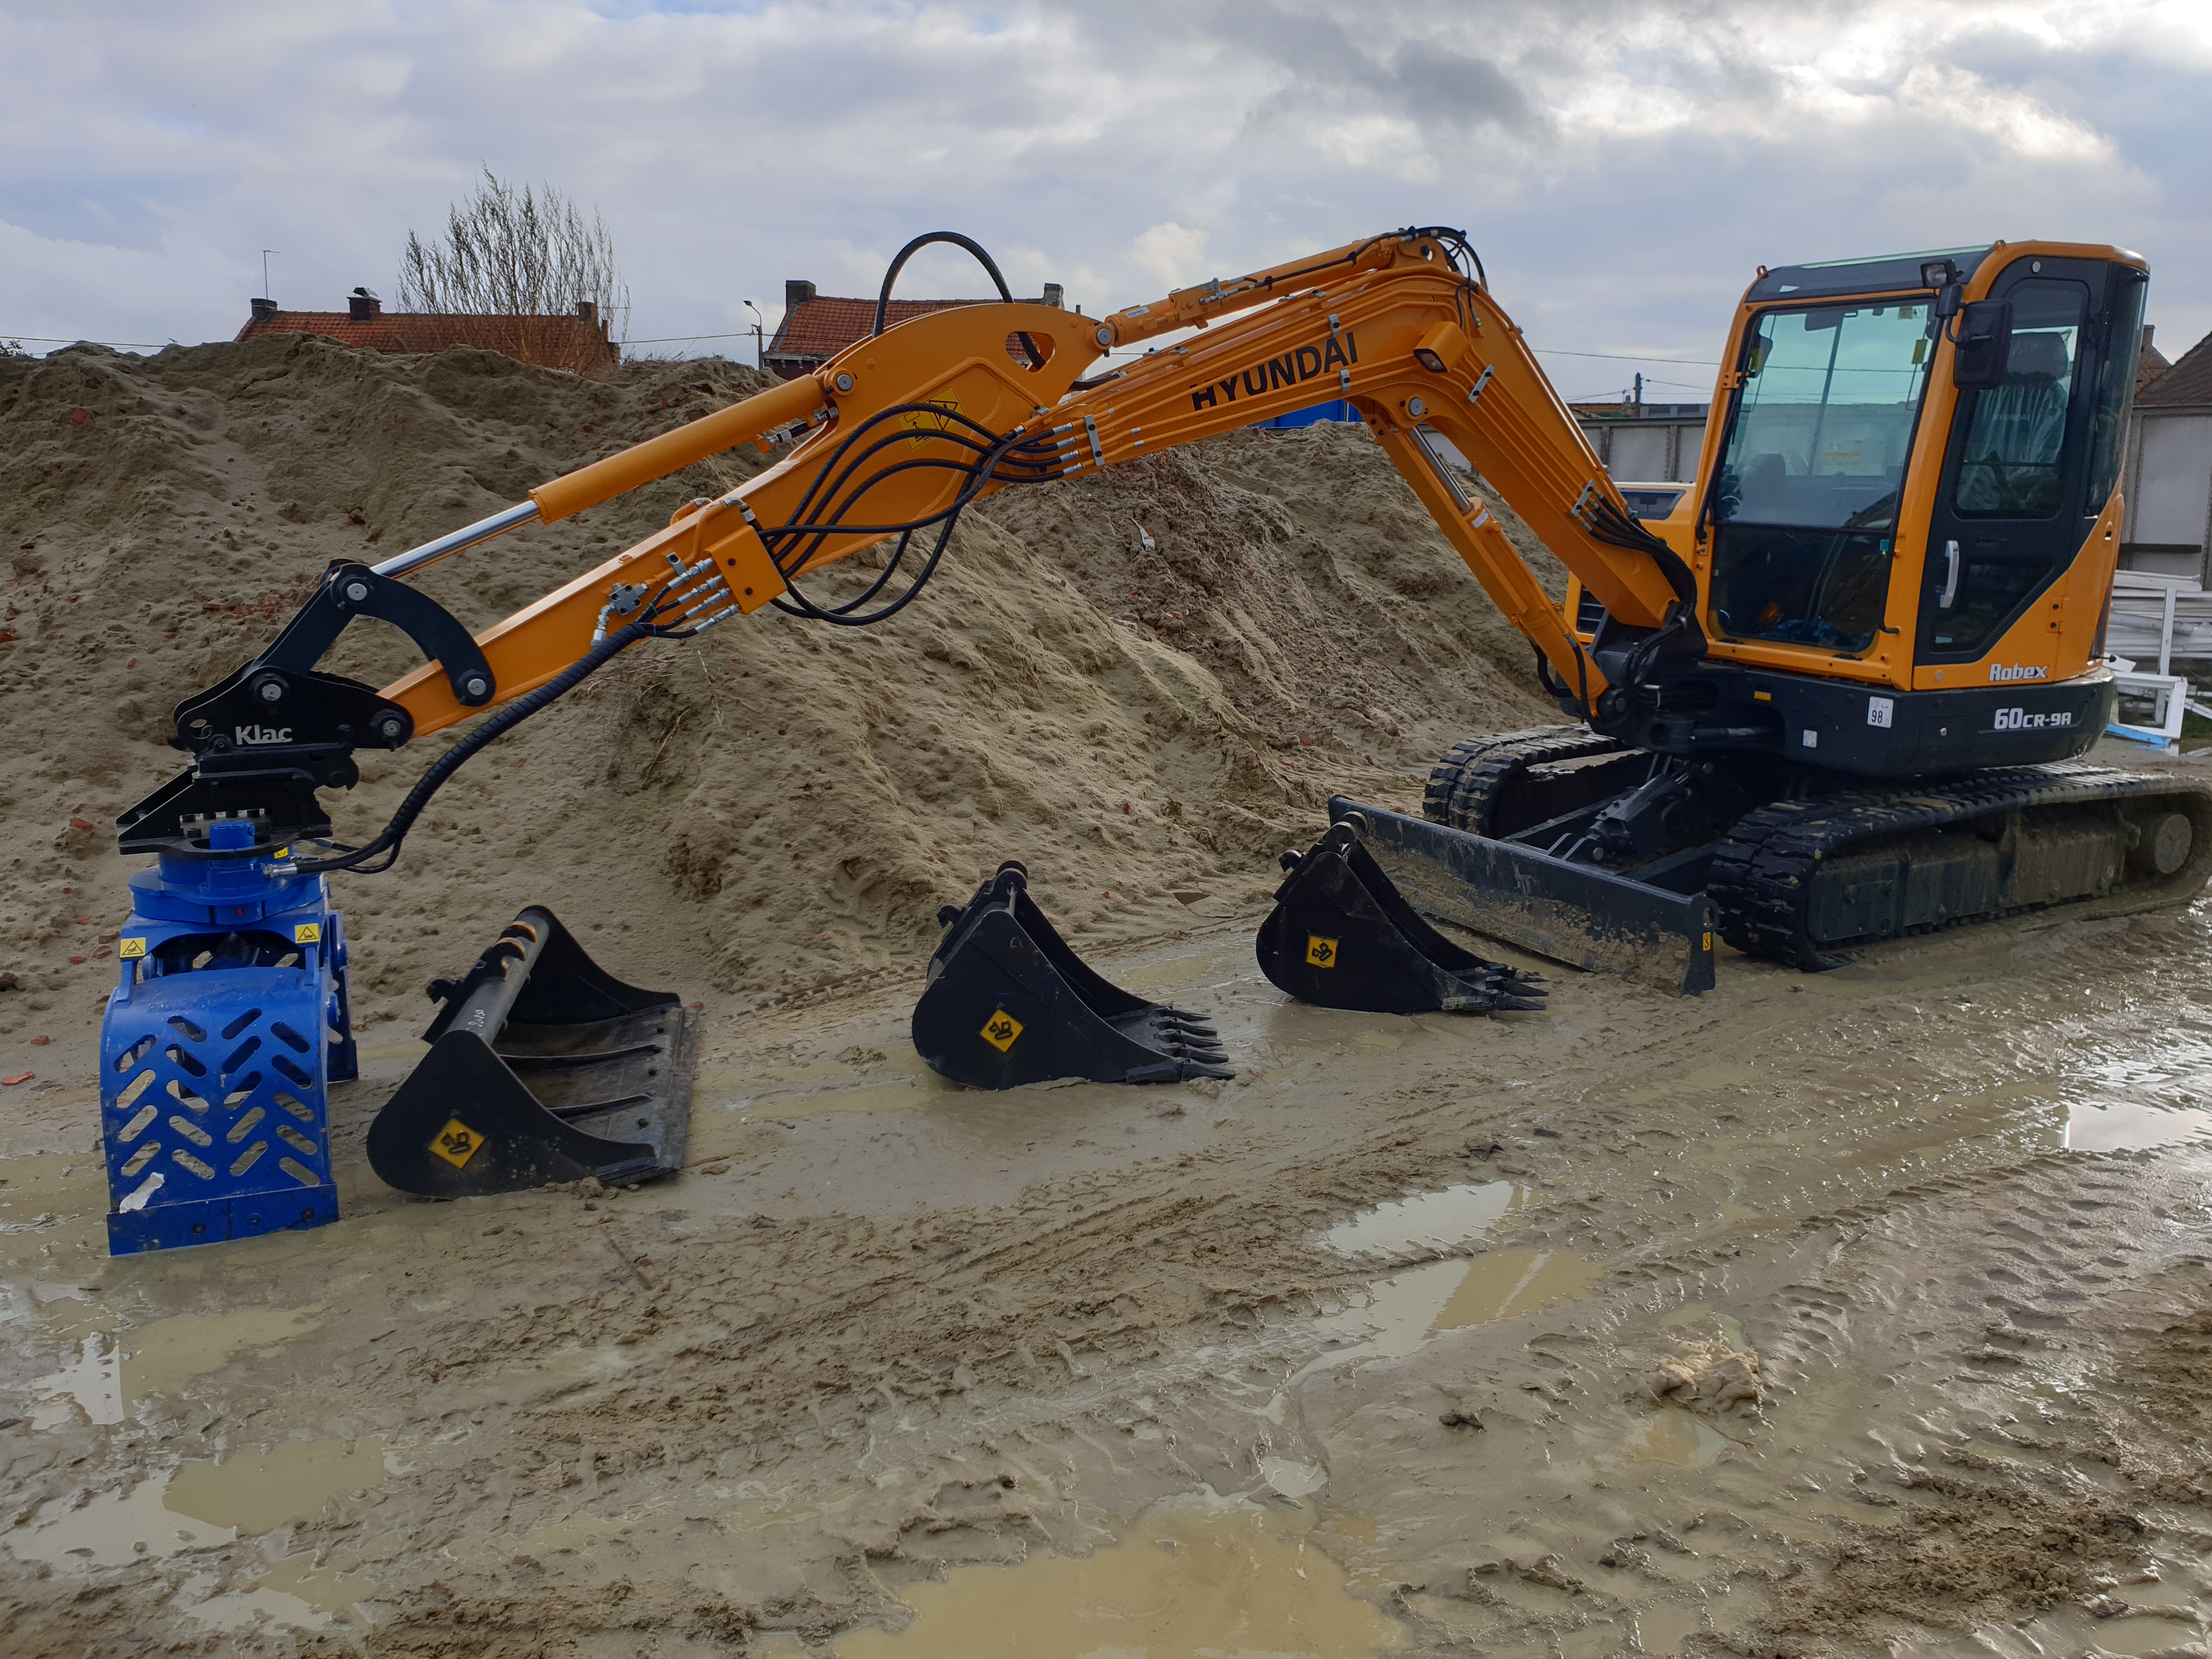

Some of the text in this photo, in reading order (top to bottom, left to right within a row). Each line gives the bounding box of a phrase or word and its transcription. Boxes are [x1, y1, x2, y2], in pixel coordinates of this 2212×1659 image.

[1189, 331, 1359, 413] HYUNDAI
[1989, 663, 2049, 682] Robex
[1871, 709, 1883, 724] 98
[1994, 707, 2072, 730] 60CR-9A
[235, 724, 293, 746] Klac
